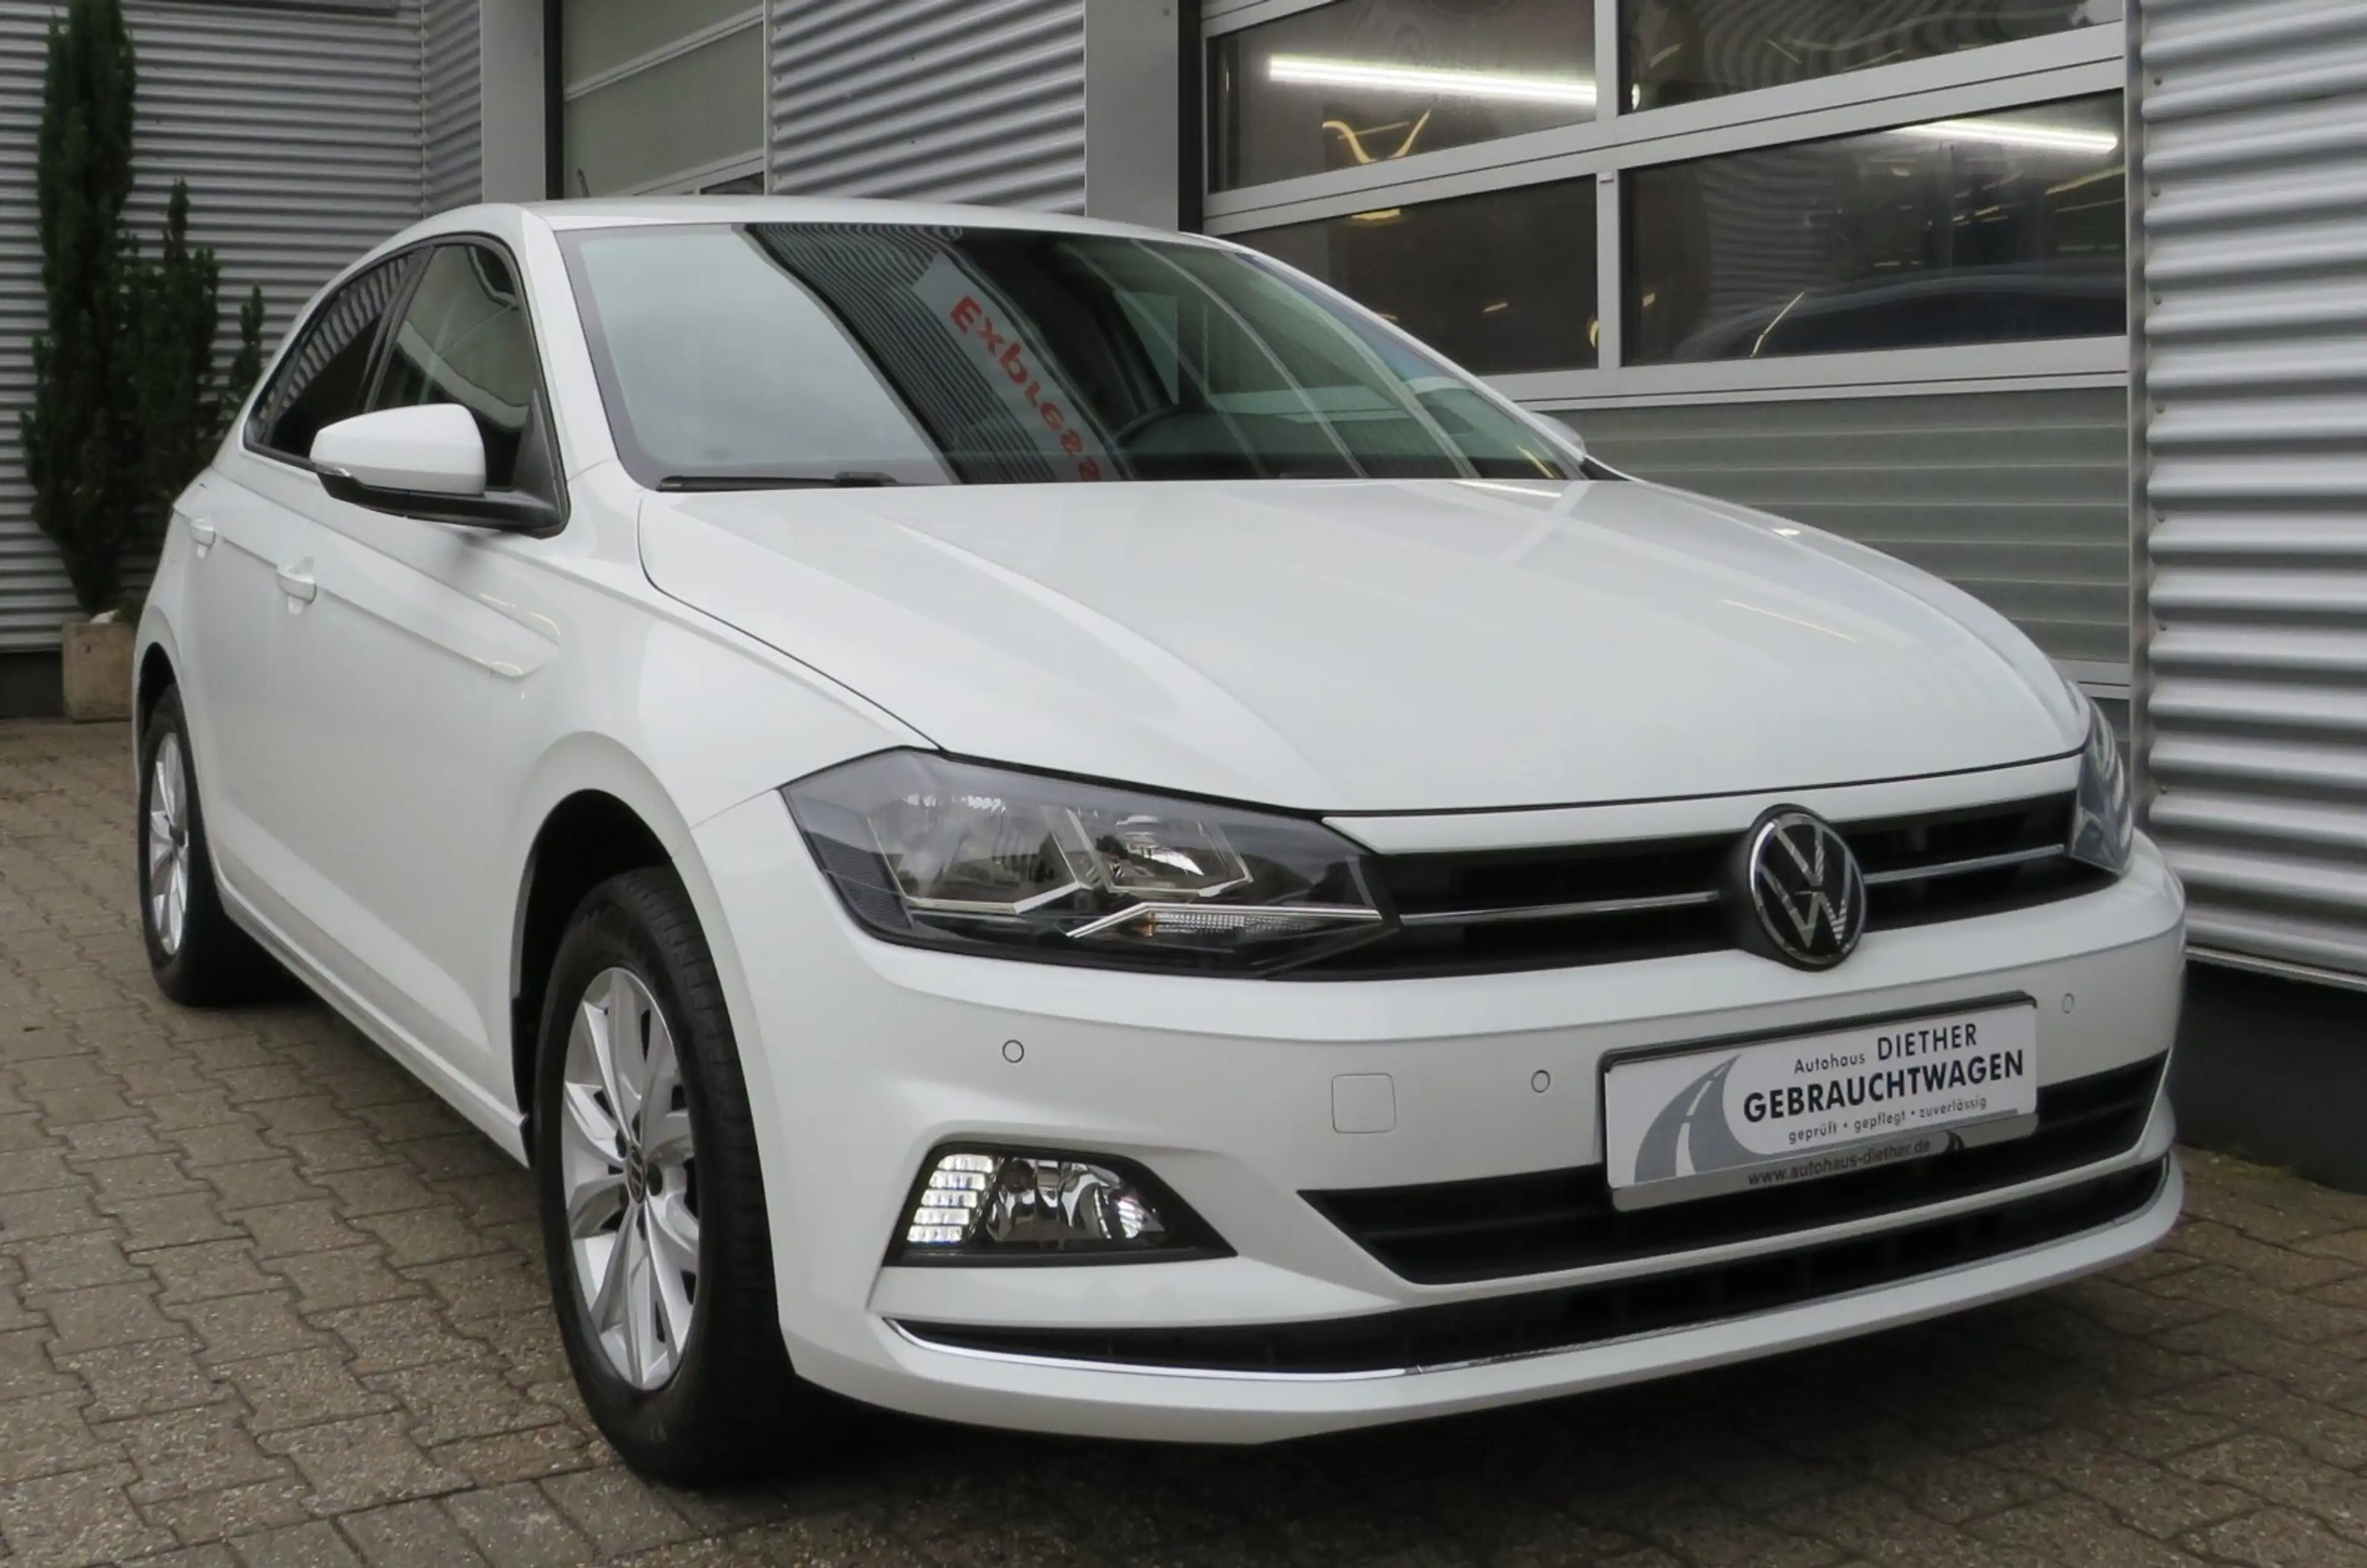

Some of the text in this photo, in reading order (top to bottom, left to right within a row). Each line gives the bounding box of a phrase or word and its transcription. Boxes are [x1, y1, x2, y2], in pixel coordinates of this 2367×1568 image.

[1794, 1023, 1977, 1074] Autohaus DIETHER
[1743, 1049, 2024, 1123] GEBRAUCHTWAGEN
[1788, 1095, 1987, 1145] geprüft gepflegt zuverlässig
[1748, 1138, 1931, 1186] www.autohaus-diether.de
